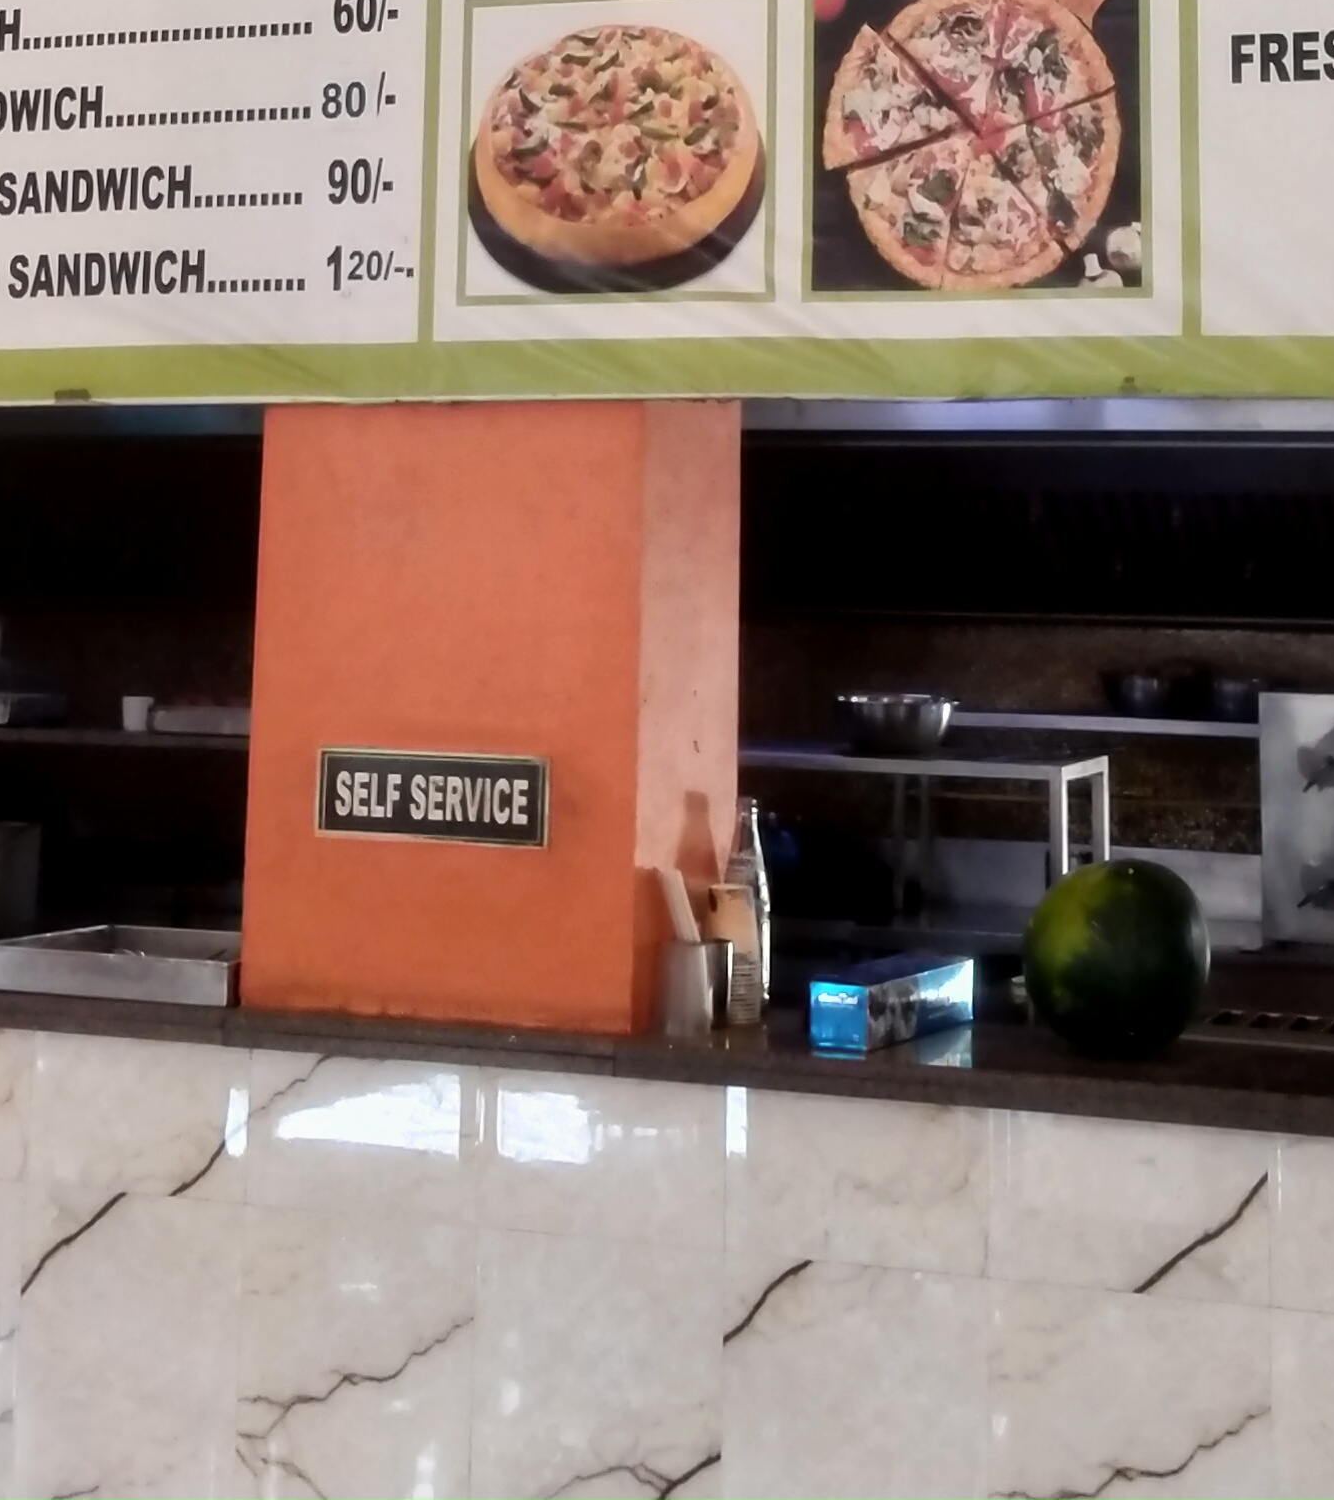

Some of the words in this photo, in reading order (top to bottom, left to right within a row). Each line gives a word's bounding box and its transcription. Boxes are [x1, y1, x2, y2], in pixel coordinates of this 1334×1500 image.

[328, 157, 394, 205] 90/-
[335, 770, 402, 818] SELF
[409, 774, 530, 825] SERVICE
